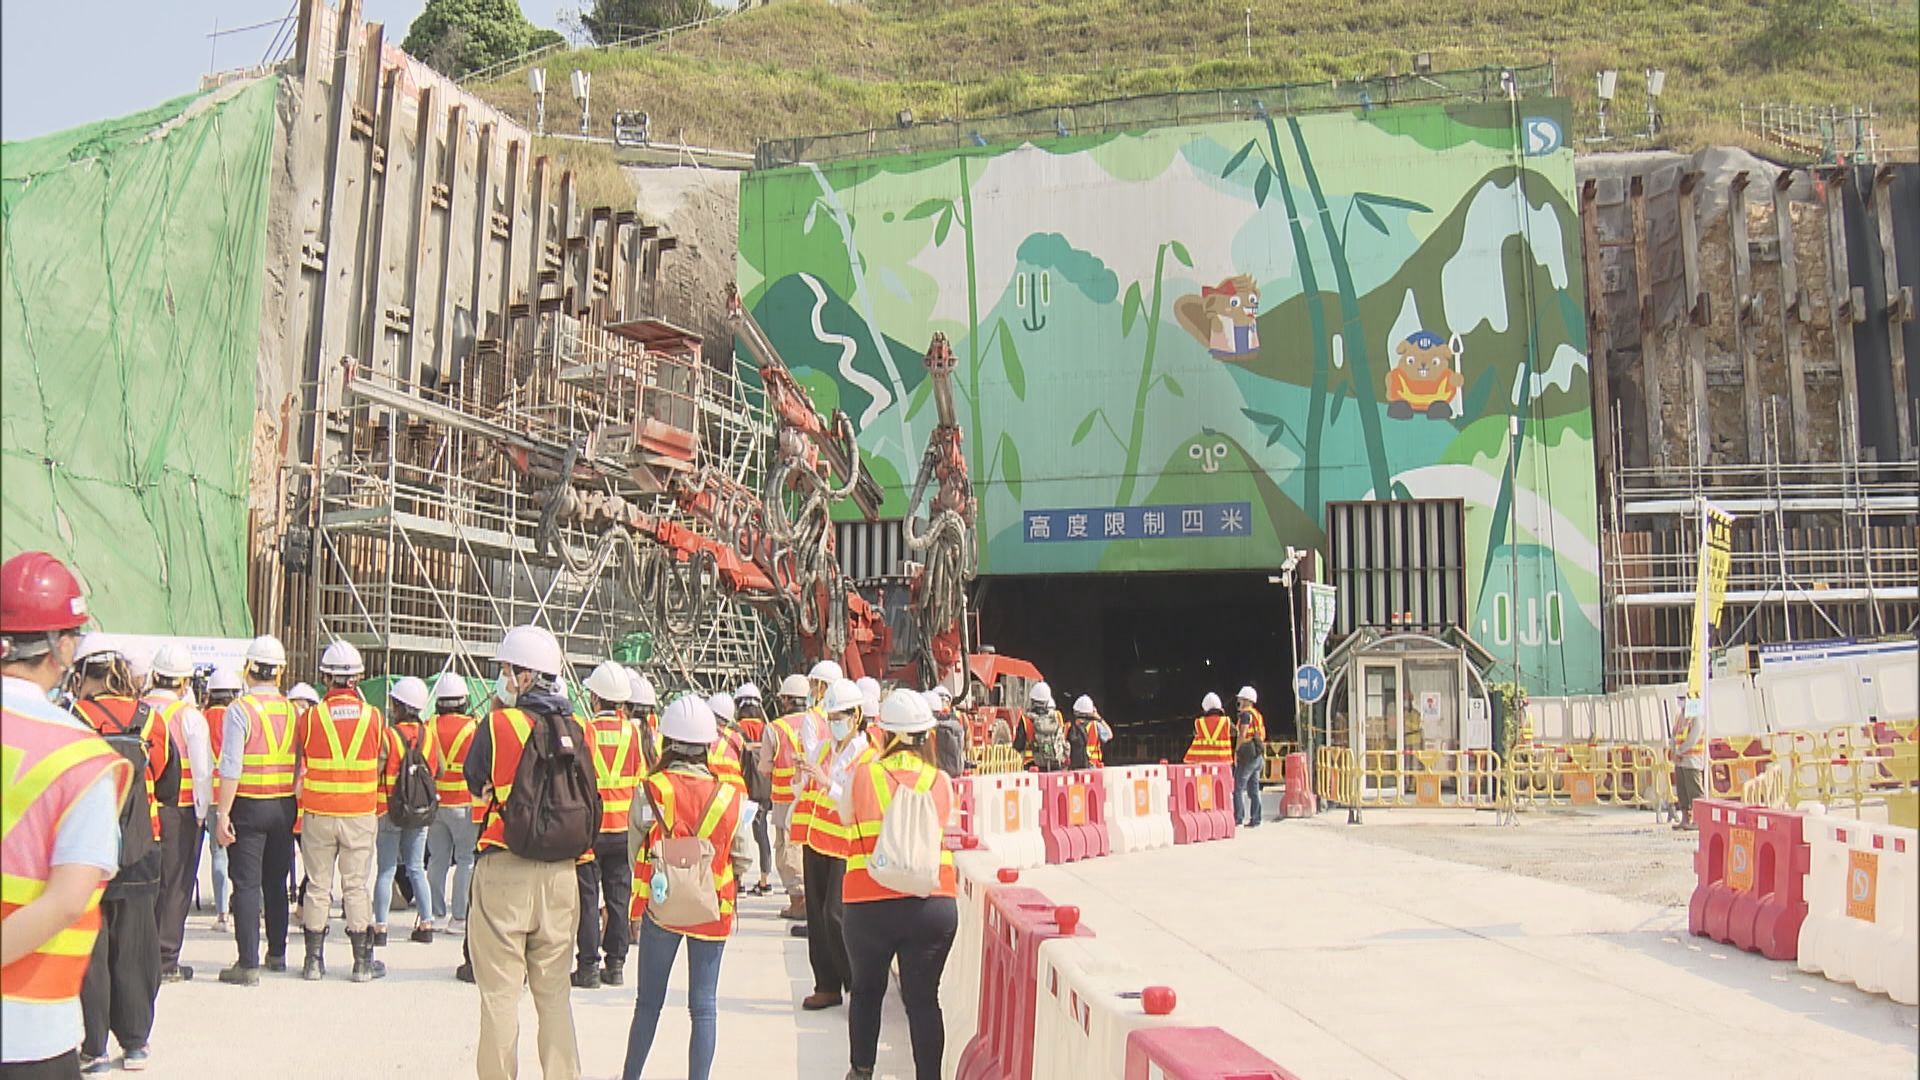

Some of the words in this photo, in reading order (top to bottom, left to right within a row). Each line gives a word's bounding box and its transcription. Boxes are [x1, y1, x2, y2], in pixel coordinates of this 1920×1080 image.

[1029, 508, 1243, 539] 高度限制四米
